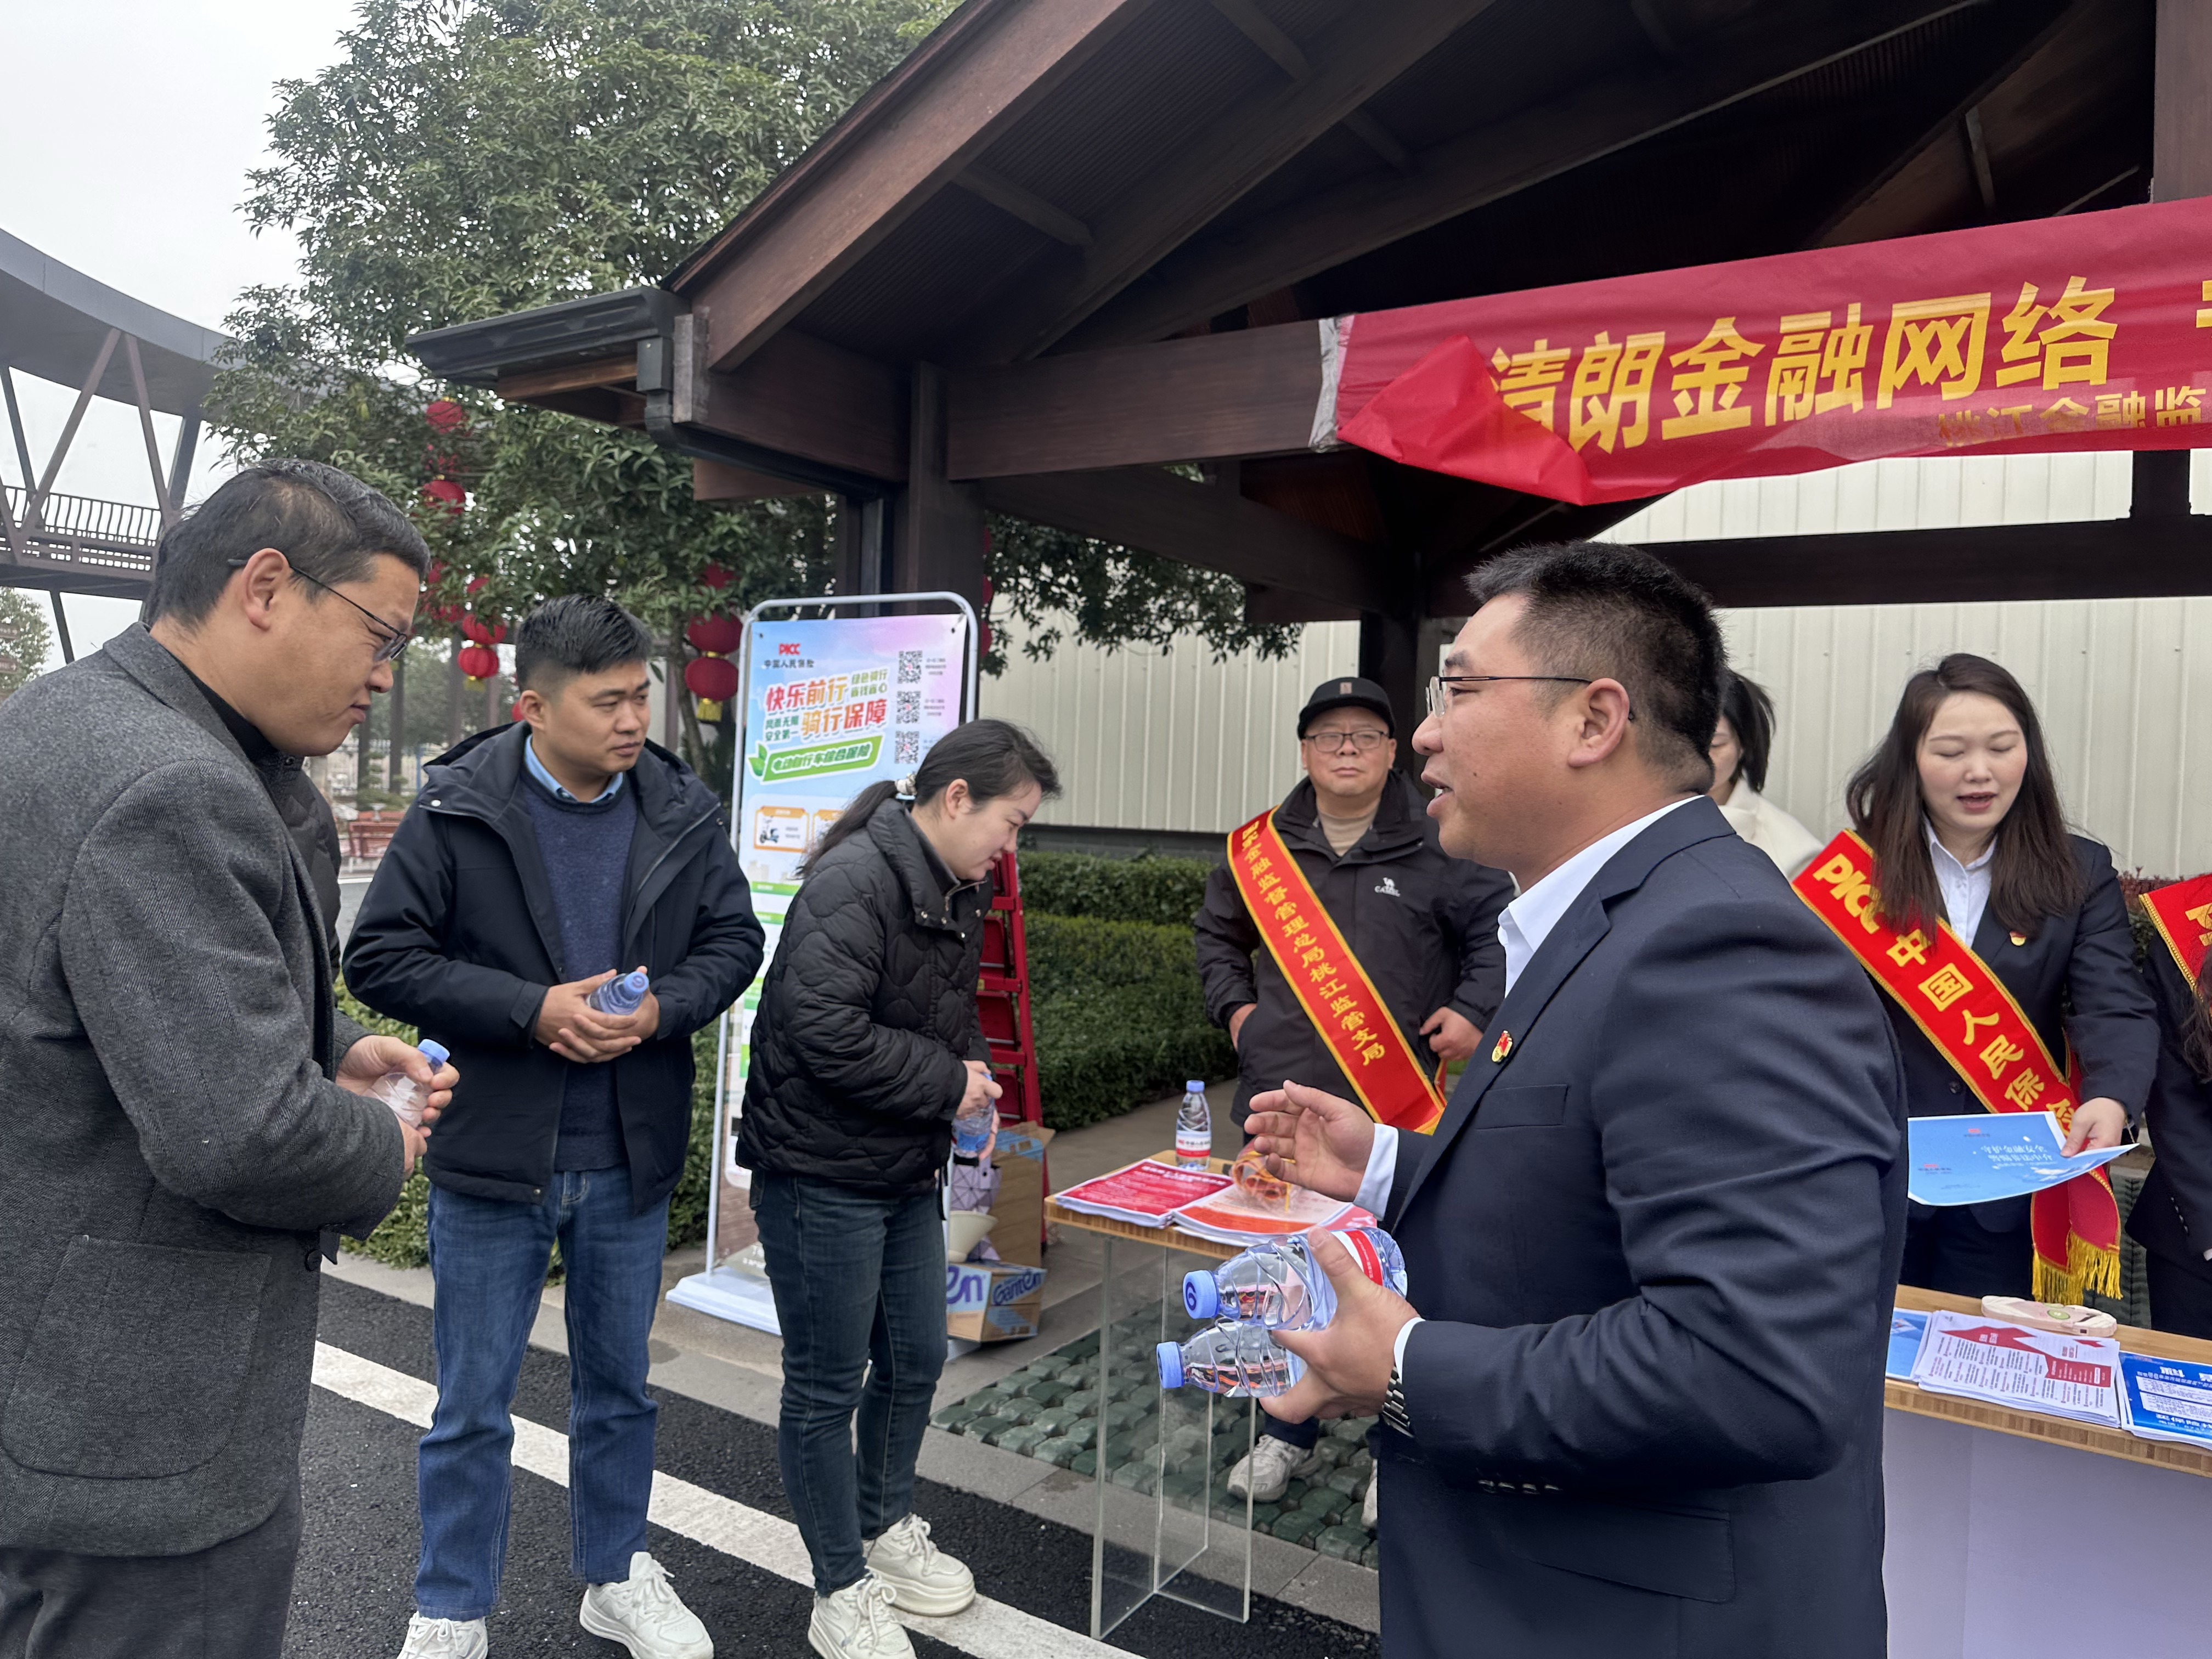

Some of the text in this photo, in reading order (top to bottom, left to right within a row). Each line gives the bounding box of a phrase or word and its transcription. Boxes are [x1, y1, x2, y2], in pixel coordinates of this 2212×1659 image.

[1490, 276, 2118, 454] 清朗金融网络
[764, 659, 815, 669] 中国人民保险
[779, 644, 801, 656] PICC
[765, 676, 848, 712] 快乐前行
[801, 698, 888, 736] 骑行保障
